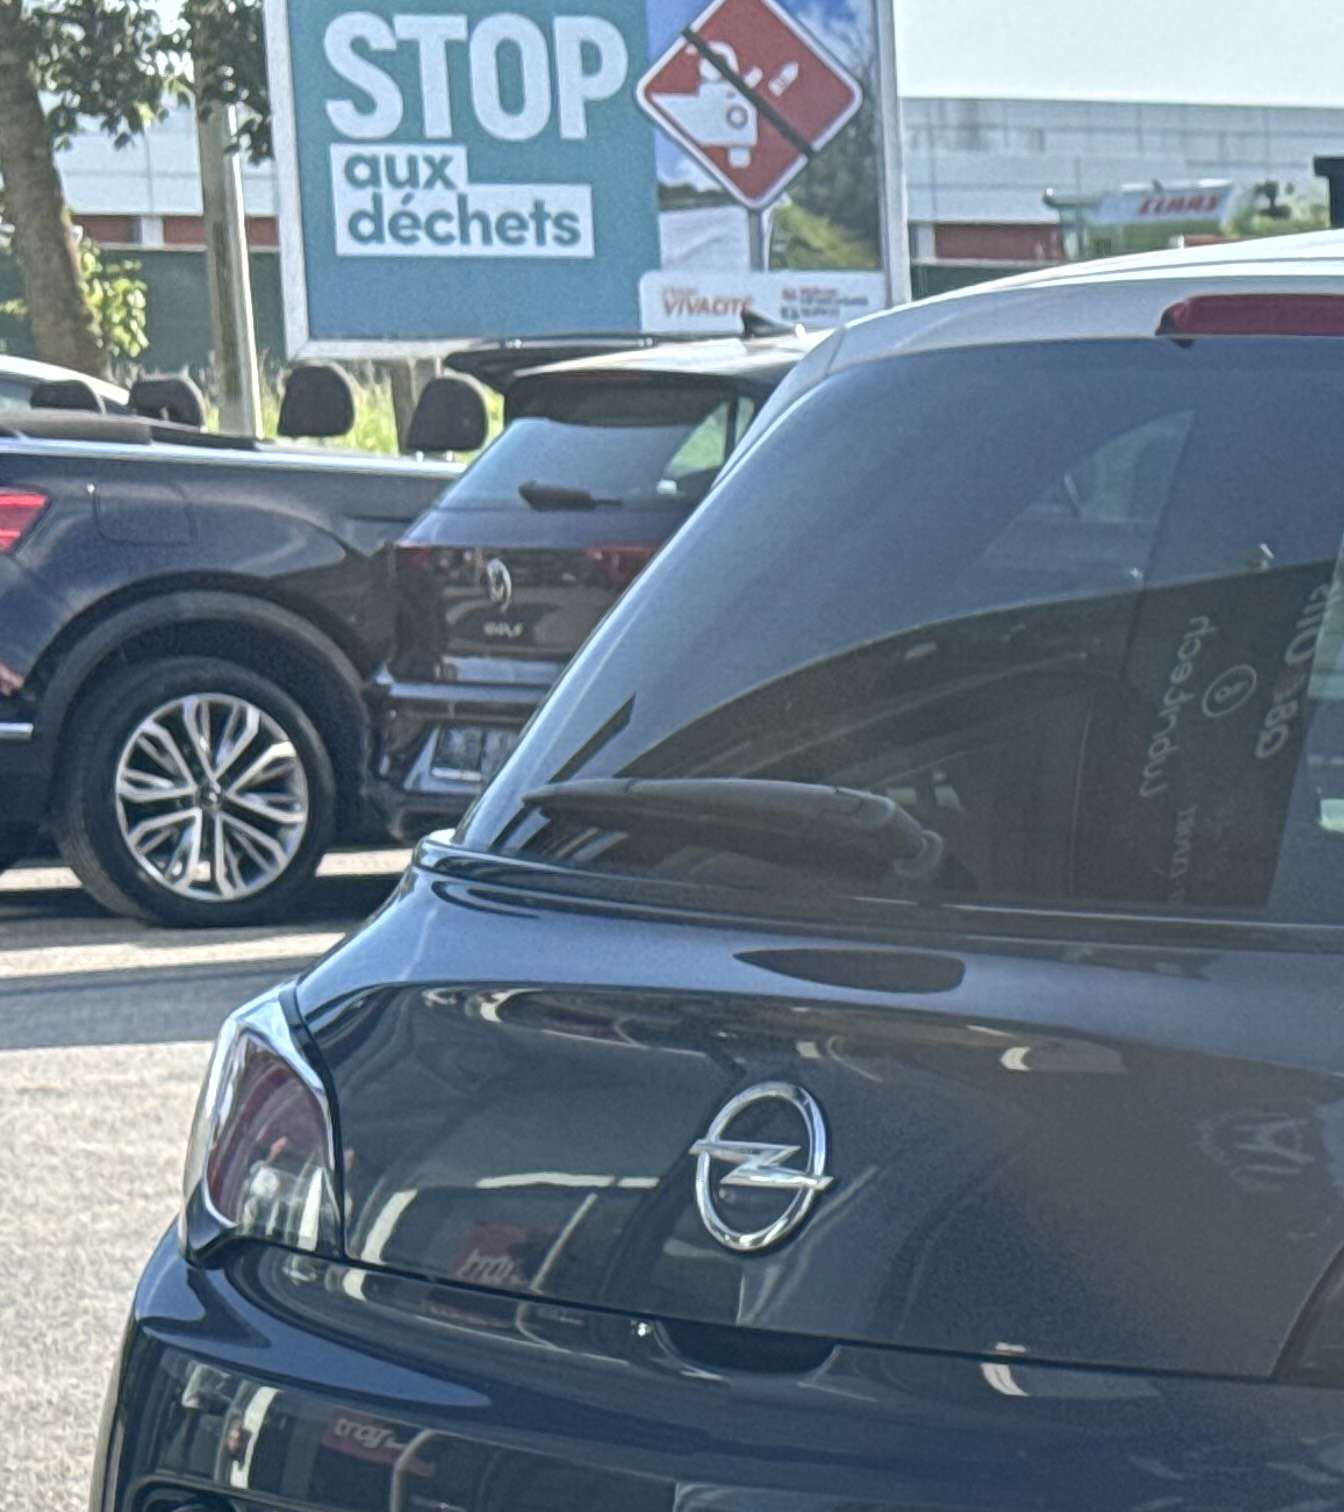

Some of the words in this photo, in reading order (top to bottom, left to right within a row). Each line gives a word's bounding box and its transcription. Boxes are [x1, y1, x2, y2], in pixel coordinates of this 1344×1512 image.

[324, 12, 627, 140] STOP
[344, 157, 455, 190] aux
[349, 194, 582, 246] déchets
